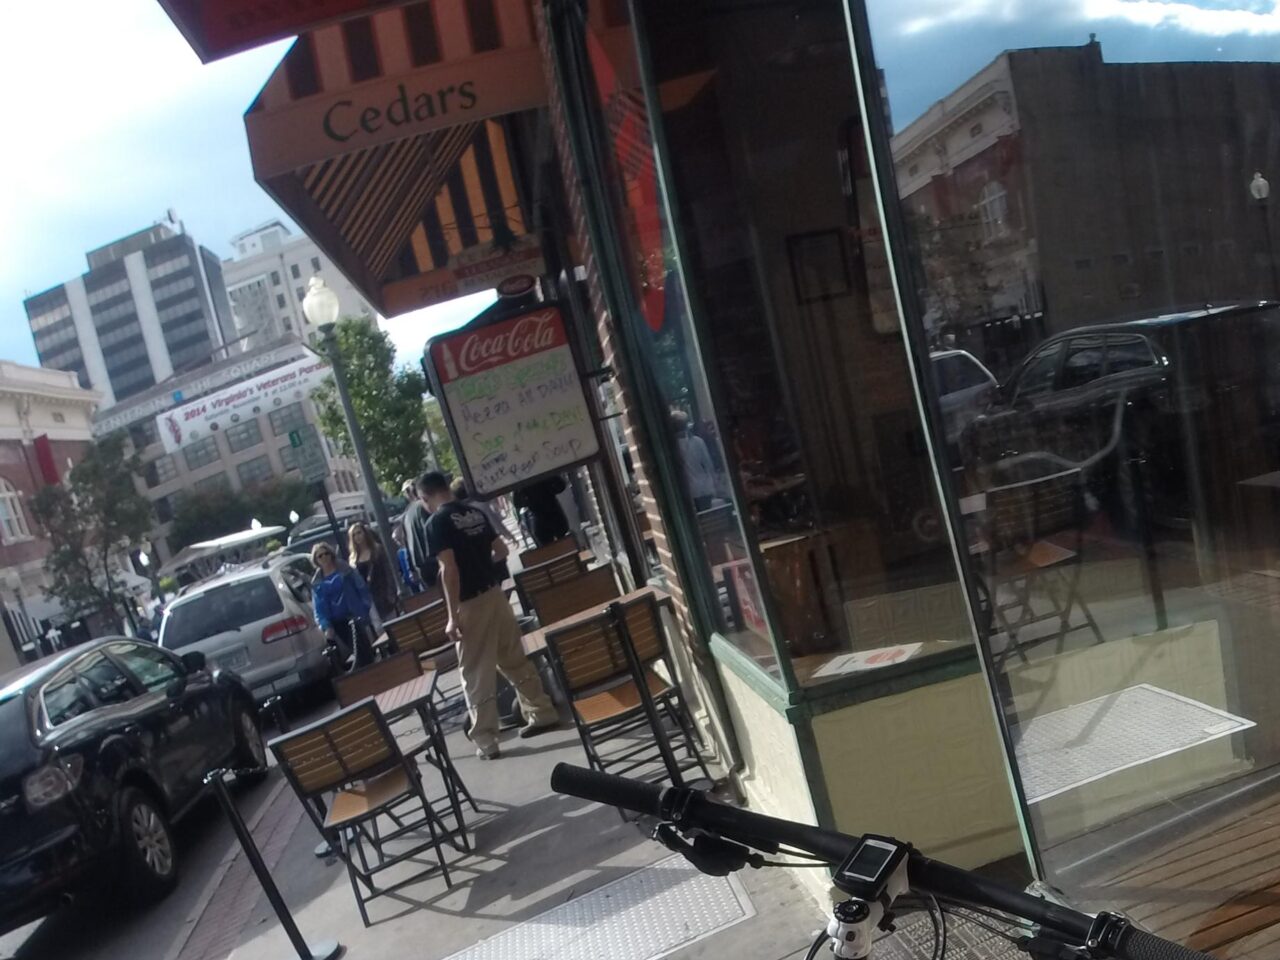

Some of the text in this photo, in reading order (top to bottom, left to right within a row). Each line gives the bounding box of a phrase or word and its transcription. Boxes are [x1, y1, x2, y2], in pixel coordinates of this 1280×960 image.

[322, 80, 478, 142] Cedars
[460, 311, 555, 372] Coca-Cola
[184, 407, 207, 421] 2014
